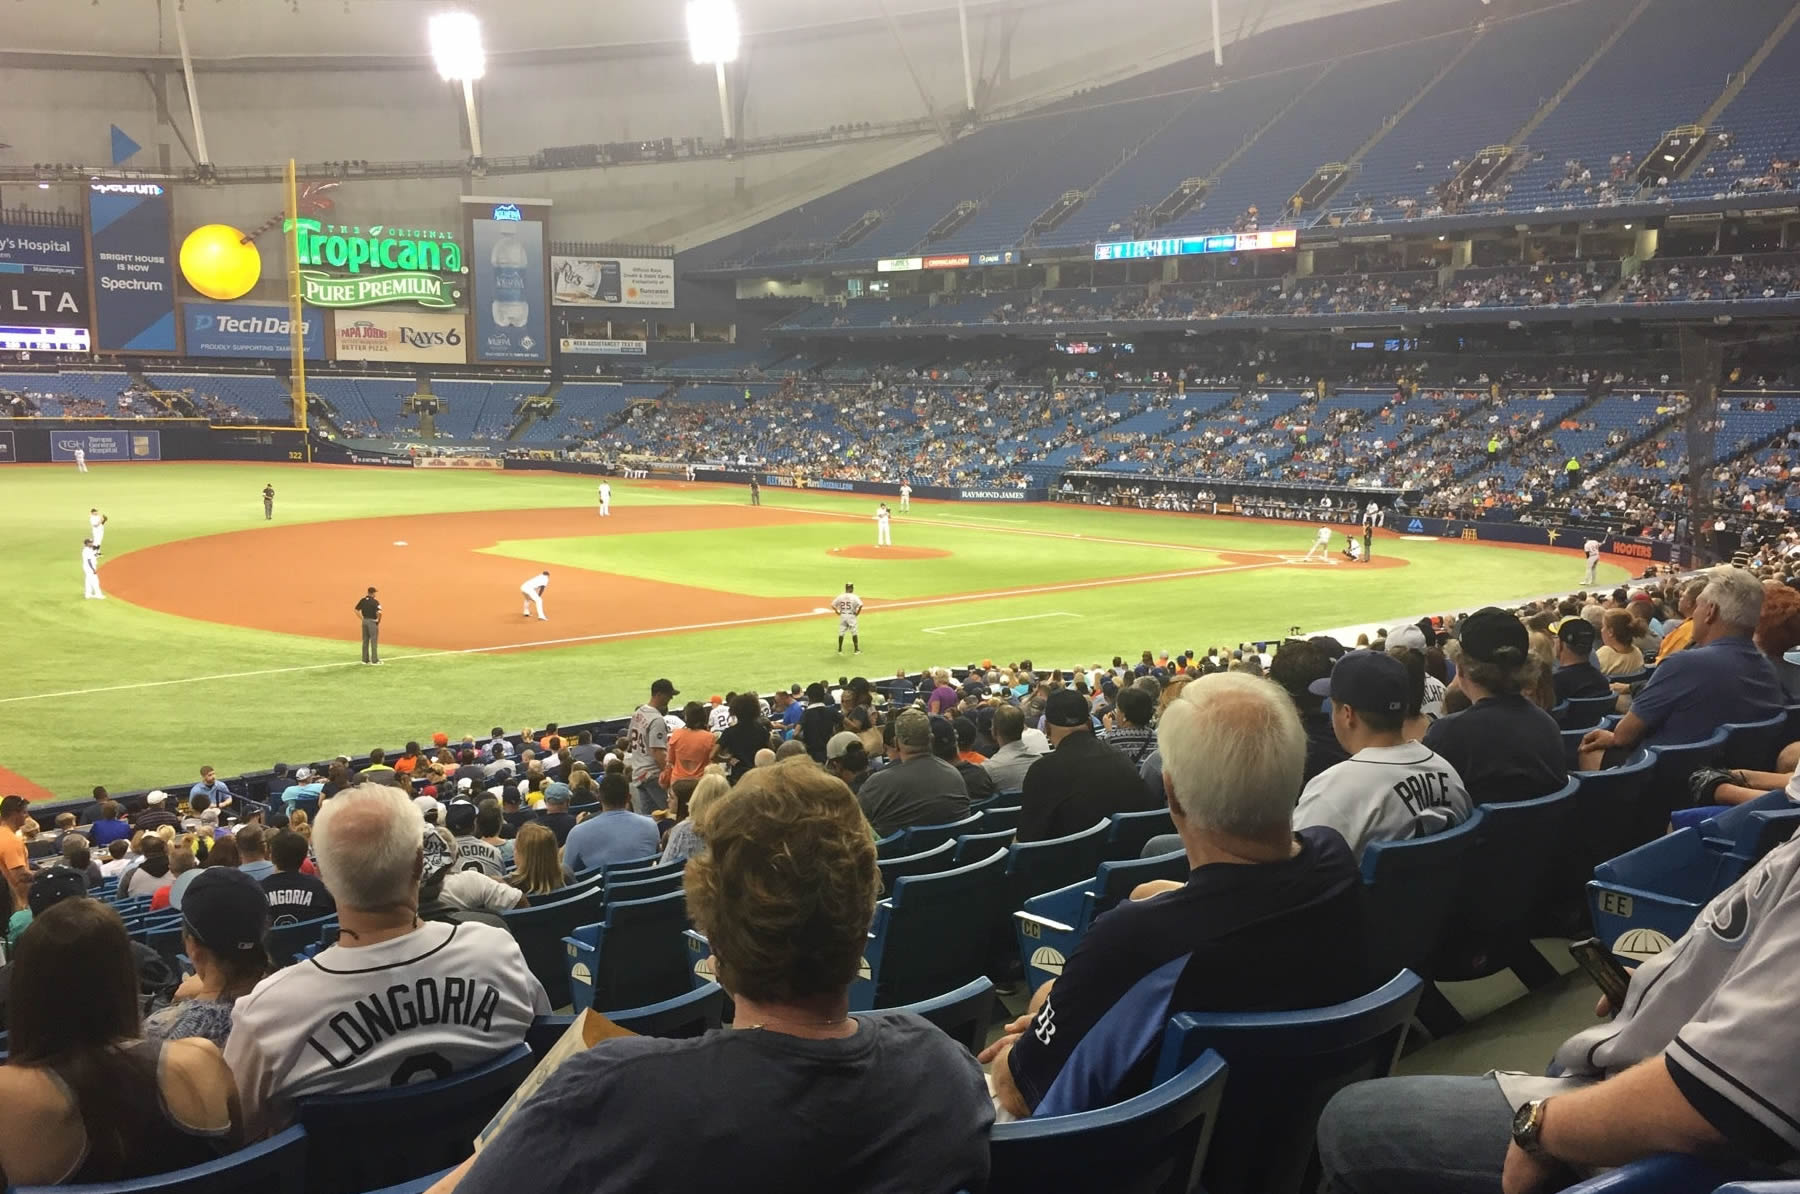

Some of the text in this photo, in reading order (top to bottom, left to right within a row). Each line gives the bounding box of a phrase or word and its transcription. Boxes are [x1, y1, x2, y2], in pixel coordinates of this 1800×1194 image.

[18, 239, 71, 253] Hospital
[284, 218, 462, 273] Tropicana
[99, 253, 165, 264] BRIGHT HOUSE
[101, 277, 163, 291] Spectrum
[359, 278, 441, 299] PREMIUM
[289, 451, 303, 459] 322
[962, 490, 1024, 499] RAYMOND JAMES
[1613, 541, 1652, 557] HOOTERS
[841, 601, 852, 610] 25
[1393, 772, 1452, 817] PRICE
[264, 889, 313, 906] NGORIA
[1604, 893, 1627, 915] EE
[1023, 921, 1039, 937] CC
[307, 977, 500, 1069] LONGORIA
